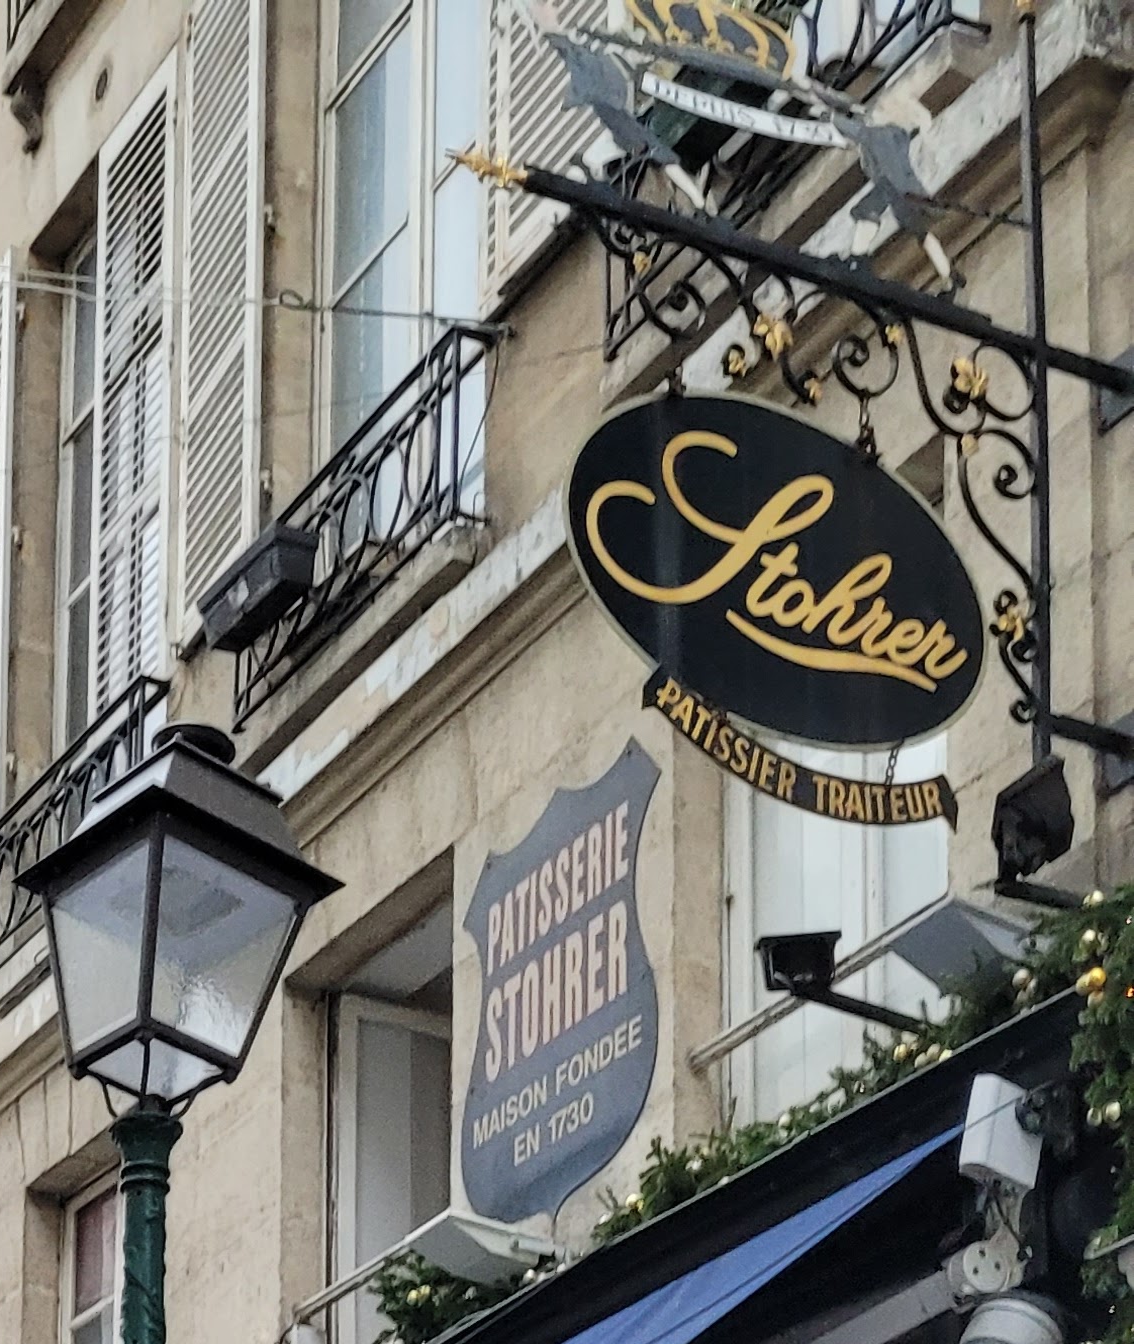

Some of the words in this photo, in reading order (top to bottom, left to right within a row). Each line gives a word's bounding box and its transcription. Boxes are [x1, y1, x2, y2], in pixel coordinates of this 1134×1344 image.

[586, 430, 967, 680] Stohrer
[812, 773, 943, 824] TRAITEUR
[485, 800, 629, 977] PATISSERIE
[484, 900, 628, 1084] STOHRER
[472, 1075, 548, 1150] MAISON
[555, 1014, 643, 1096] FONDEE
[513, 1124, 540, 1167] EN
[547, 1091, 594, 1145] 1730
